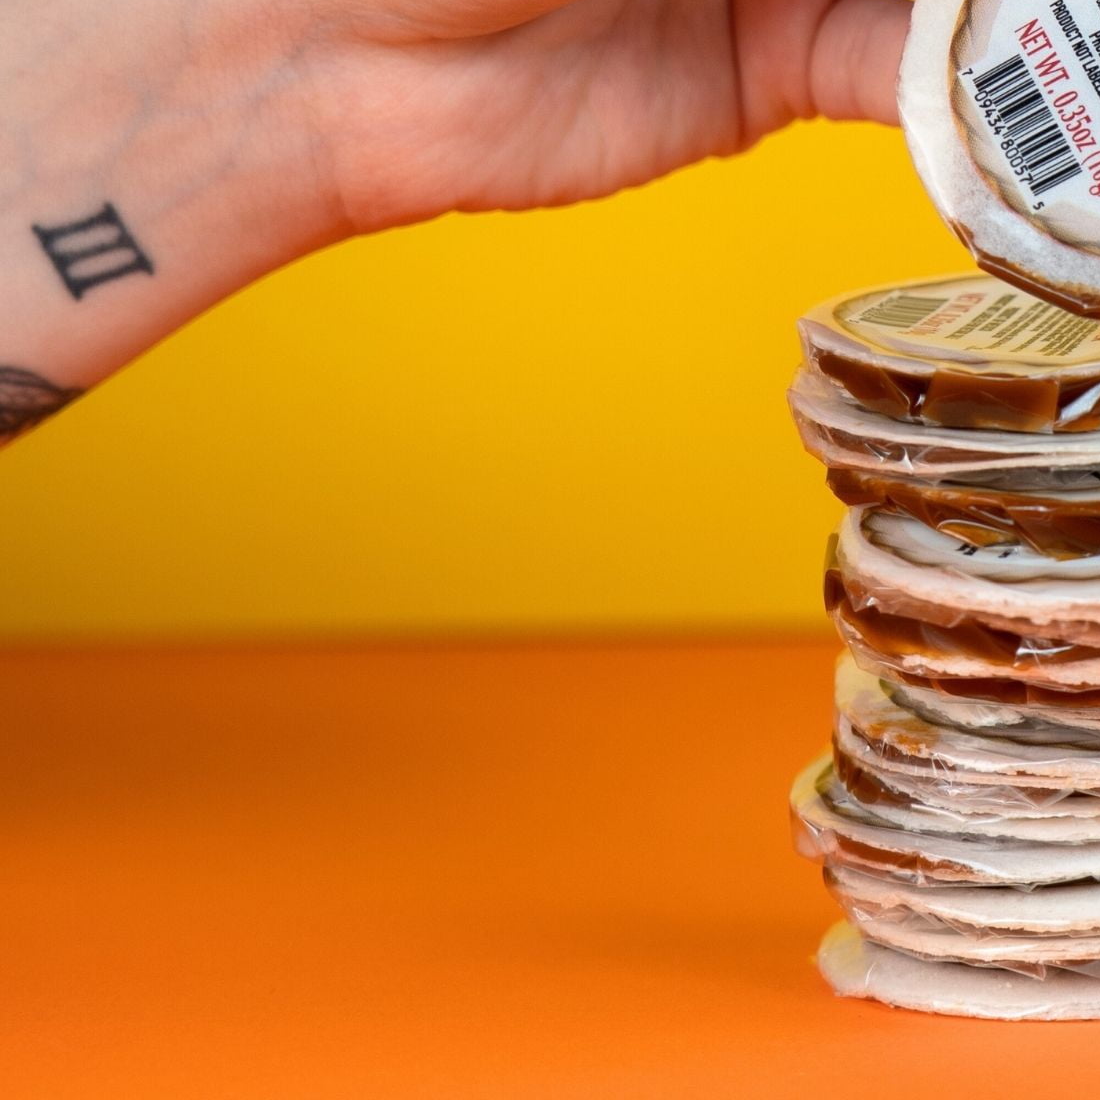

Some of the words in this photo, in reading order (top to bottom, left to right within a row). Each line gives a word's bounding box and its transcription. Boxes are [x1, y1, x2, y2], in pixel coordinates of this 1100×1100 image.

[1014, 18, 1052, 56] NET
[1034, 51, 1069, 94] WT.
[1053, 90, 1096, 152] 0.35oz
[1071, 39, 1093, 61] NOT
[961, 68, 974, 77] 7
[973, 90, 1007, 136] 09434
[1000, 139, 1034, 186] 80057
[1032, 201, 1045, 211] 5
